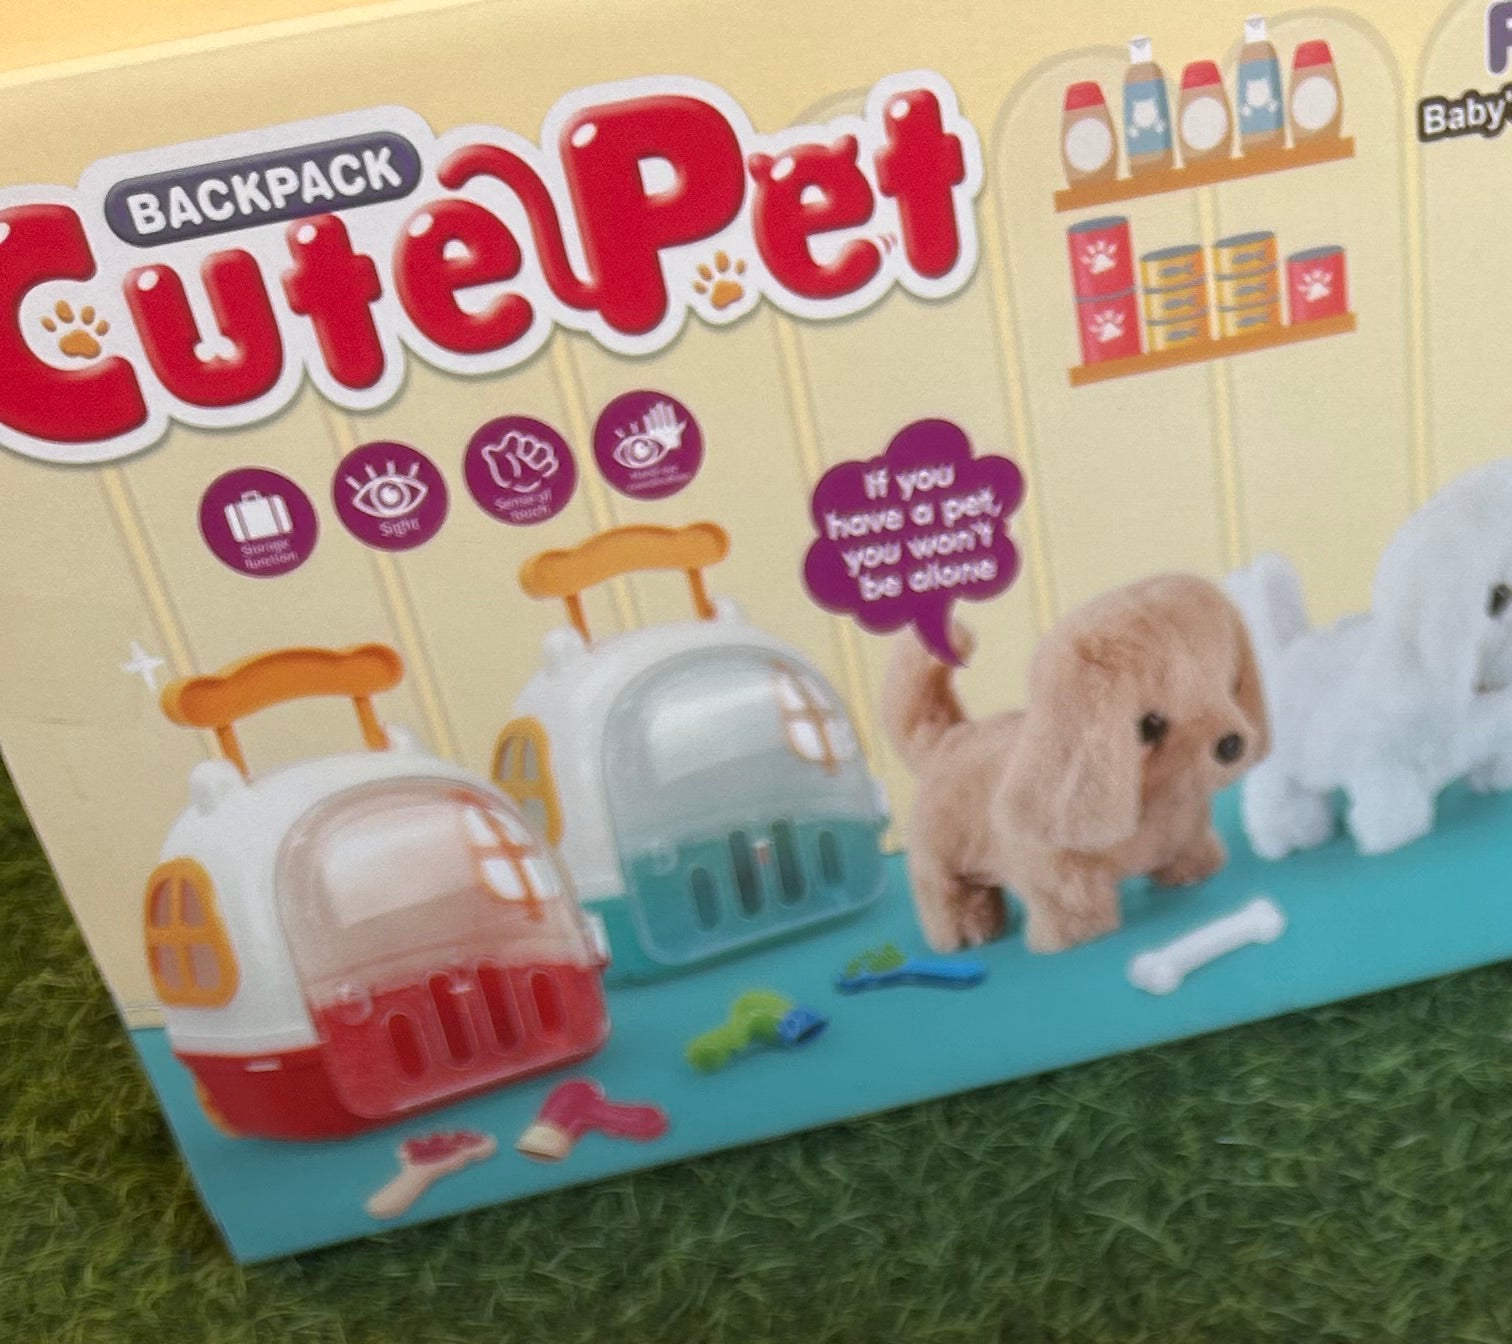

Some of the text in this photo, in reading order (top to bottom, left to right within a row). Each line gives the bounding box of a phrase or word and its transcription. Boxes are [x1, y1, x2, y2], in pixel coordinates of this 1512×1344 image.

[127, 147, 402, 235] BACKPACK
[0, 88, 966, 443] Cute Pet
[864, 463, 956, 501] If you
[824, 485, 1003, 541] have a pet,
[841, 519, 994, 578] you won't
[858, 559, 998, 602] be alone
